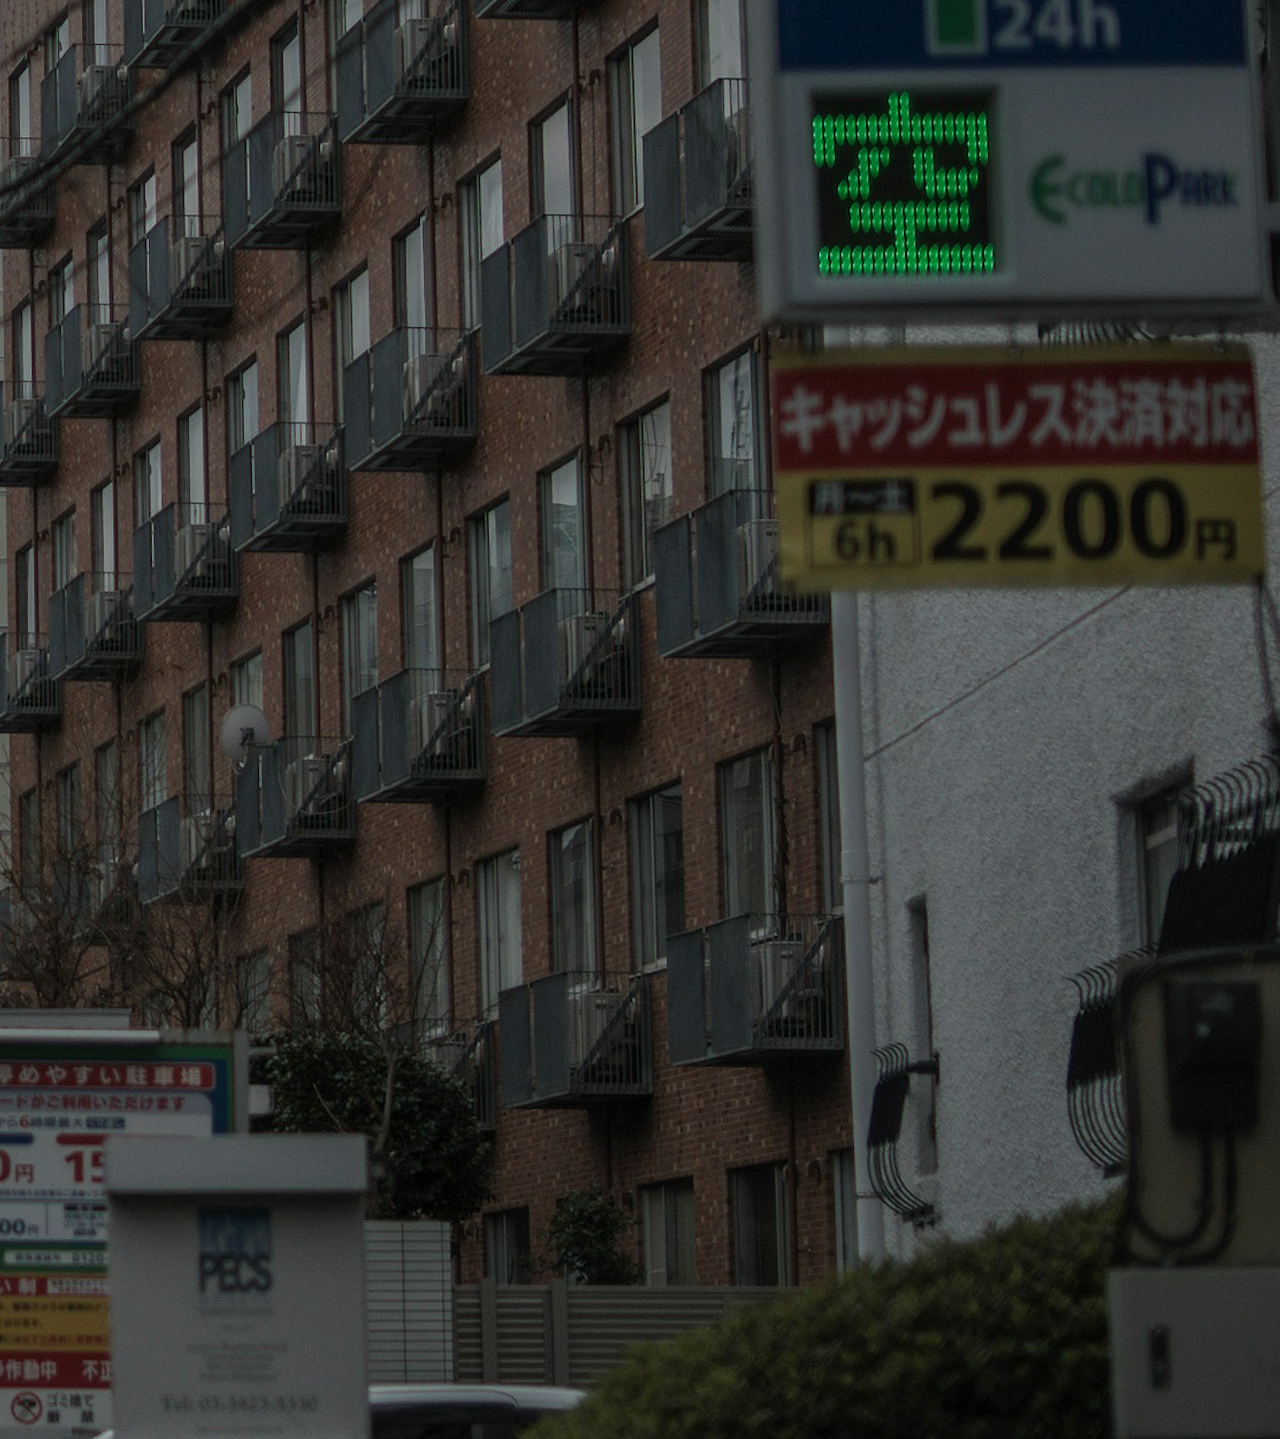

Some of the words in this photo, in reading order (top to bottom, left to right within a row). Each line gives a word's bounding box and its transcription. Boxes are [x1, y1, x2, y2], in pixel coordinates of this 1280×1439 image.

[813, 91, 995, 277] 空
[779, 372, 1255, 455] キャッシュレス決済対応
[834, 522, 896, 561] 6h
[931, 477, 1237, 563] 2200円
[198, 1253, 272, 1292] PECS
